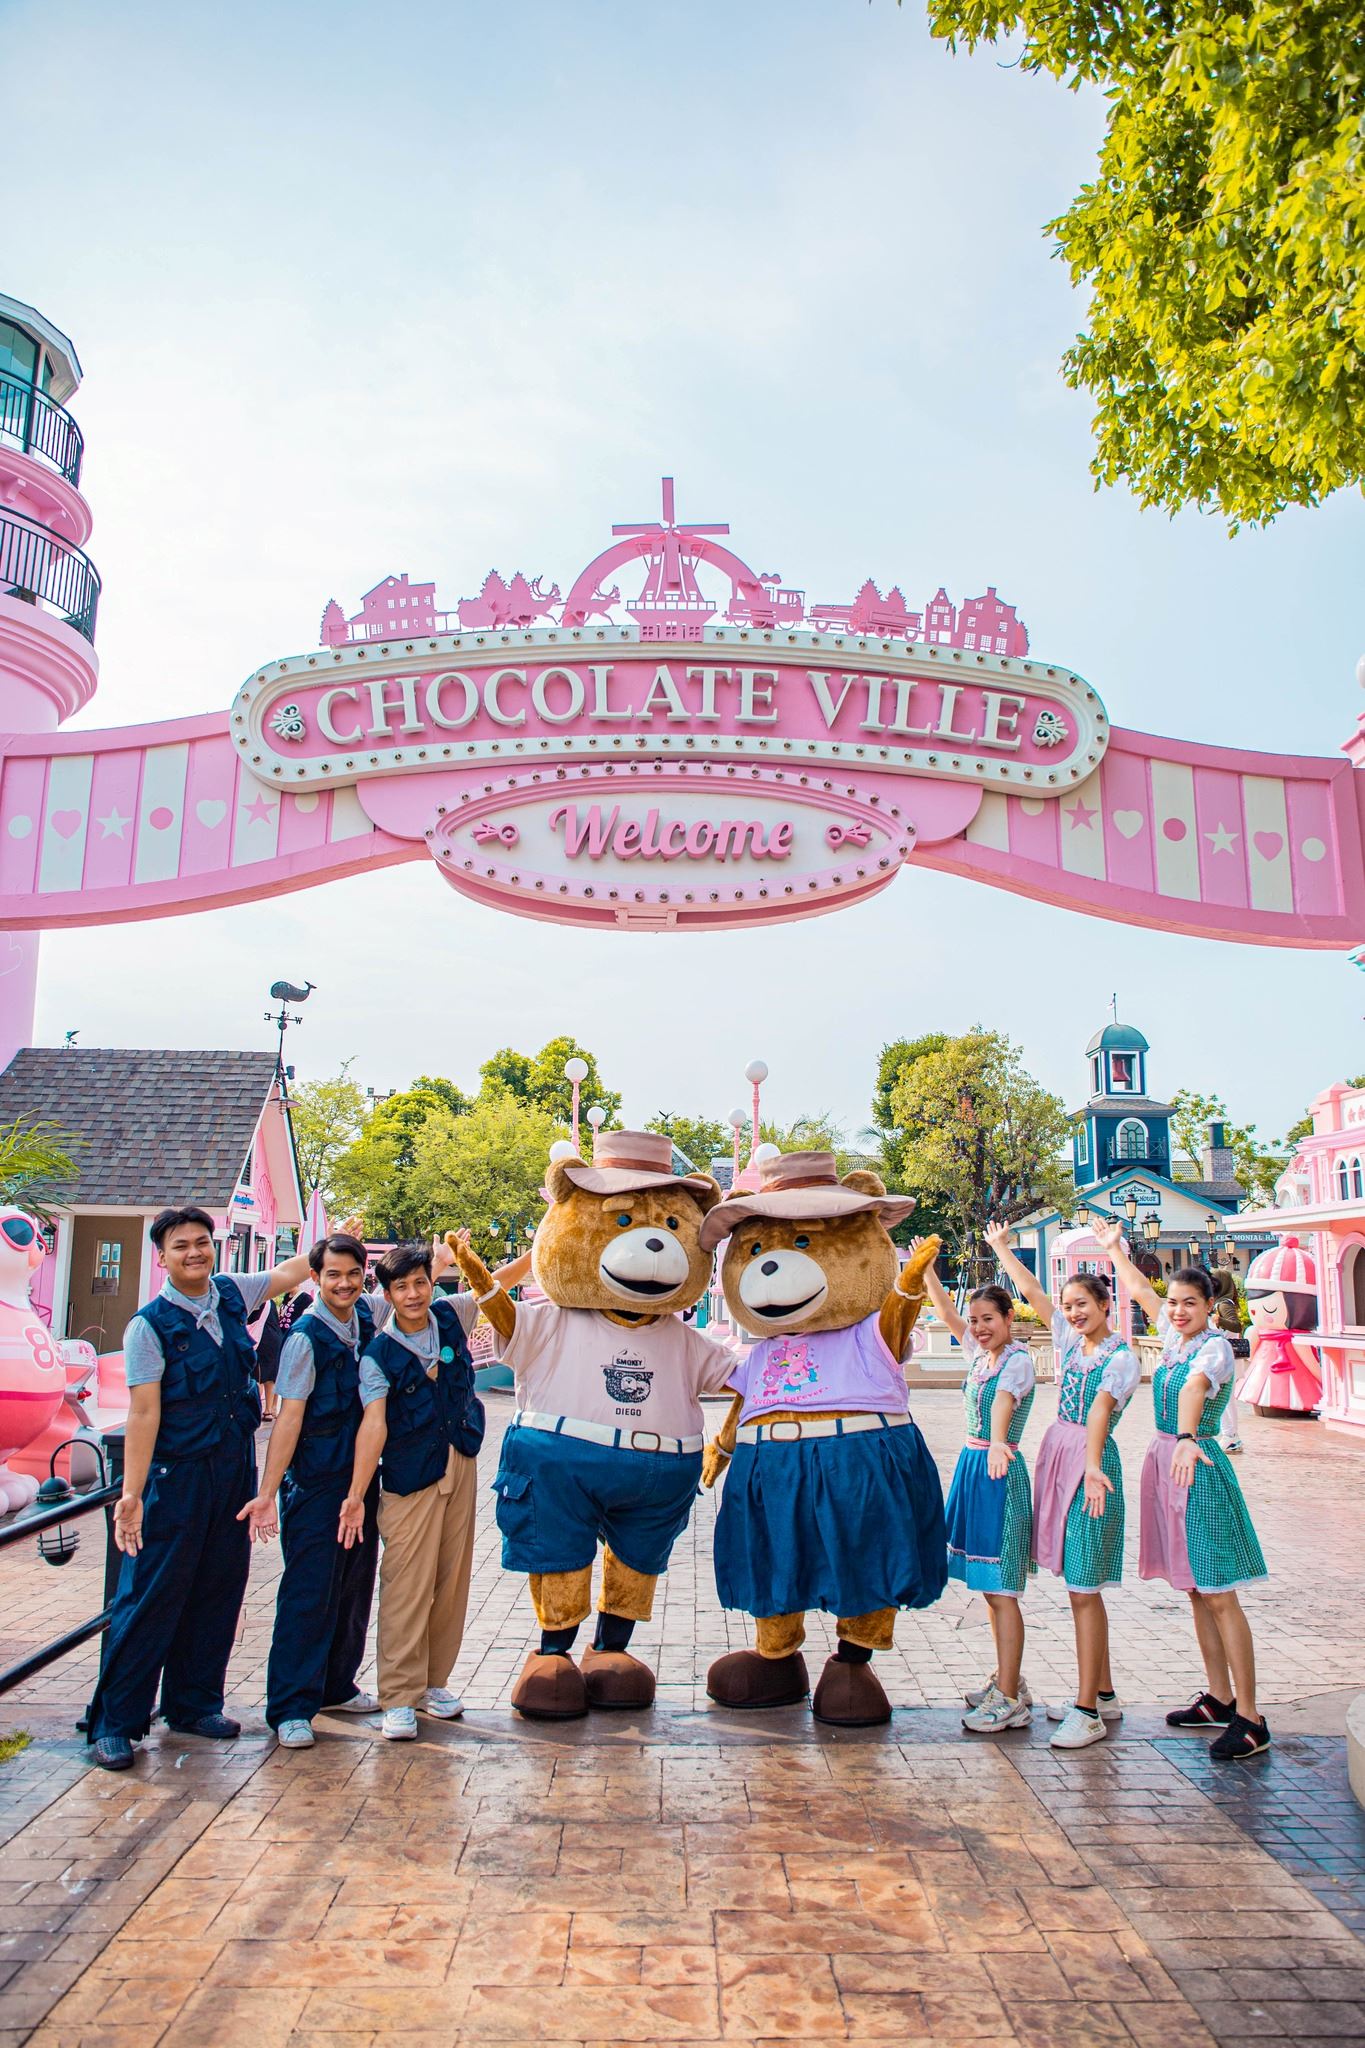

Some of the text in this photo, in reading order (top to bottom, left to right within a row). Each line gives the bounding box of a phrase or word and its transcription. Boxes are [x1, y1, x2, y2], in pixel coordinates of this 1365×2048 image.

[316, 664, 1026, 751] CHOCOLATE VILLE
[548, 804, 795, 861] Welcome
[616, 1358, 642, 1366] SMOKEY
[615, 1407, 642, 1417] DIEGO
